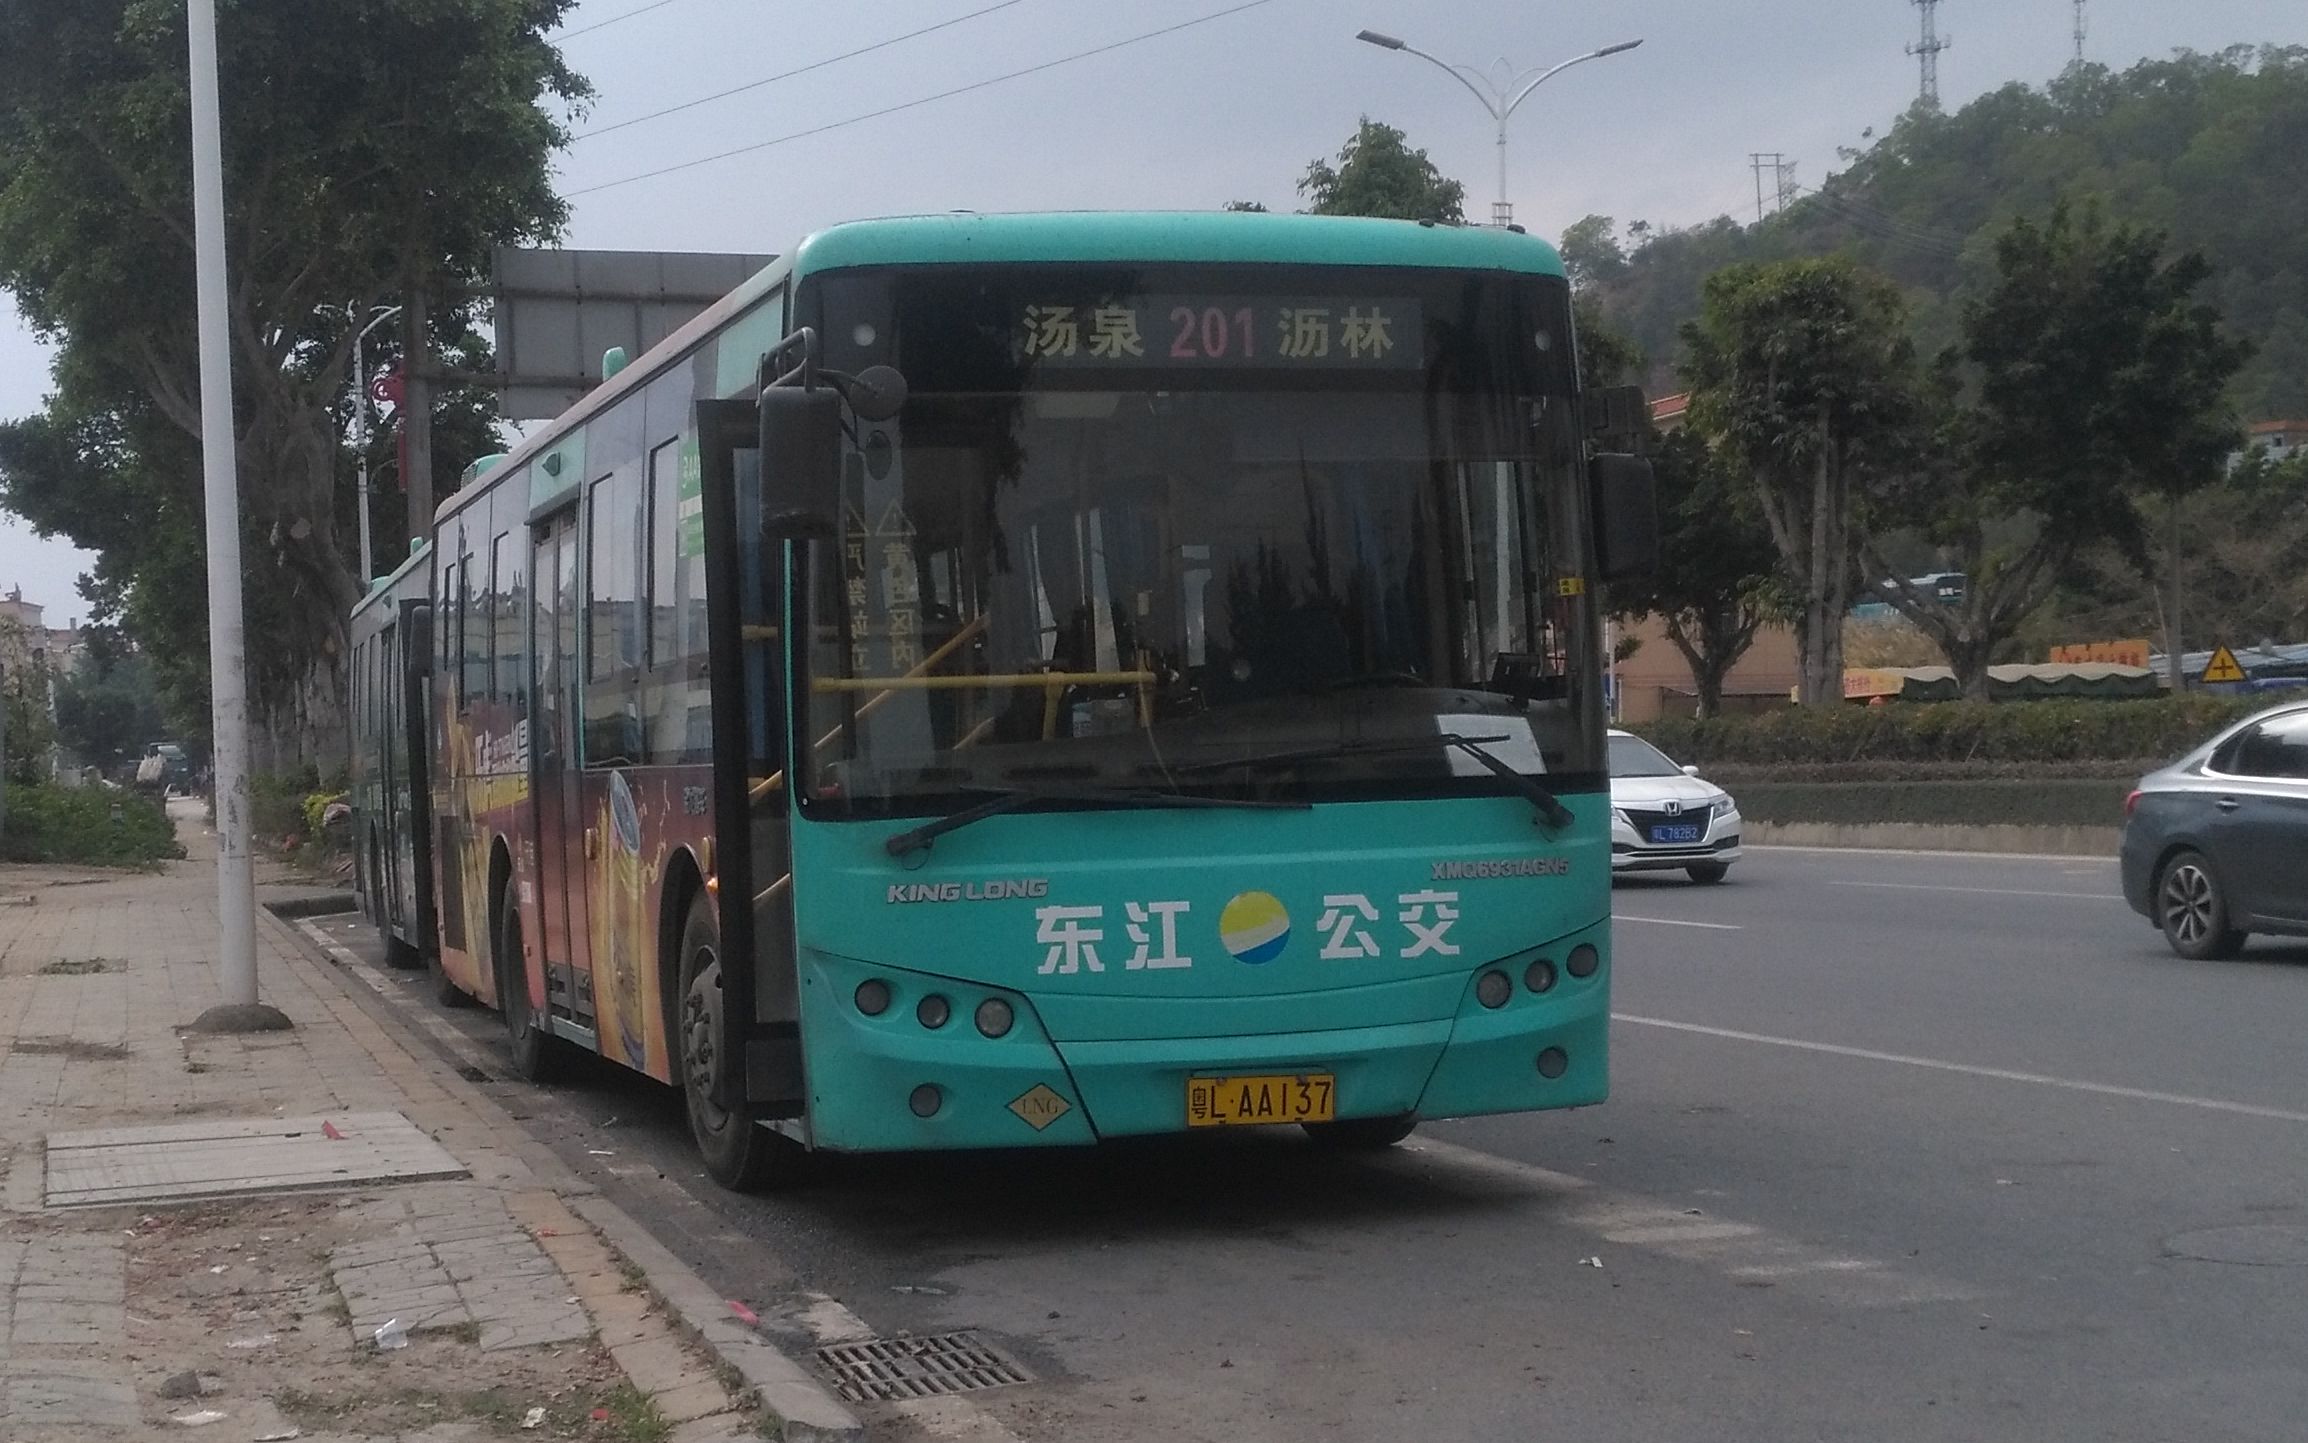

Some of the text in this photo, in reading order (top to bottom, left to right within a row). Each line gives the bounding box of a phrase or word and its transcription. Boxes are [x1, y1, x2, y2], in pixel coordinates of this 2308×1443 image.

[1023, 304, 1394, 358] 汤泉 201 沥林
[887, 879, 1048, 904] KING LONG
[1035, 888, 1461, 975] 东江 公交
